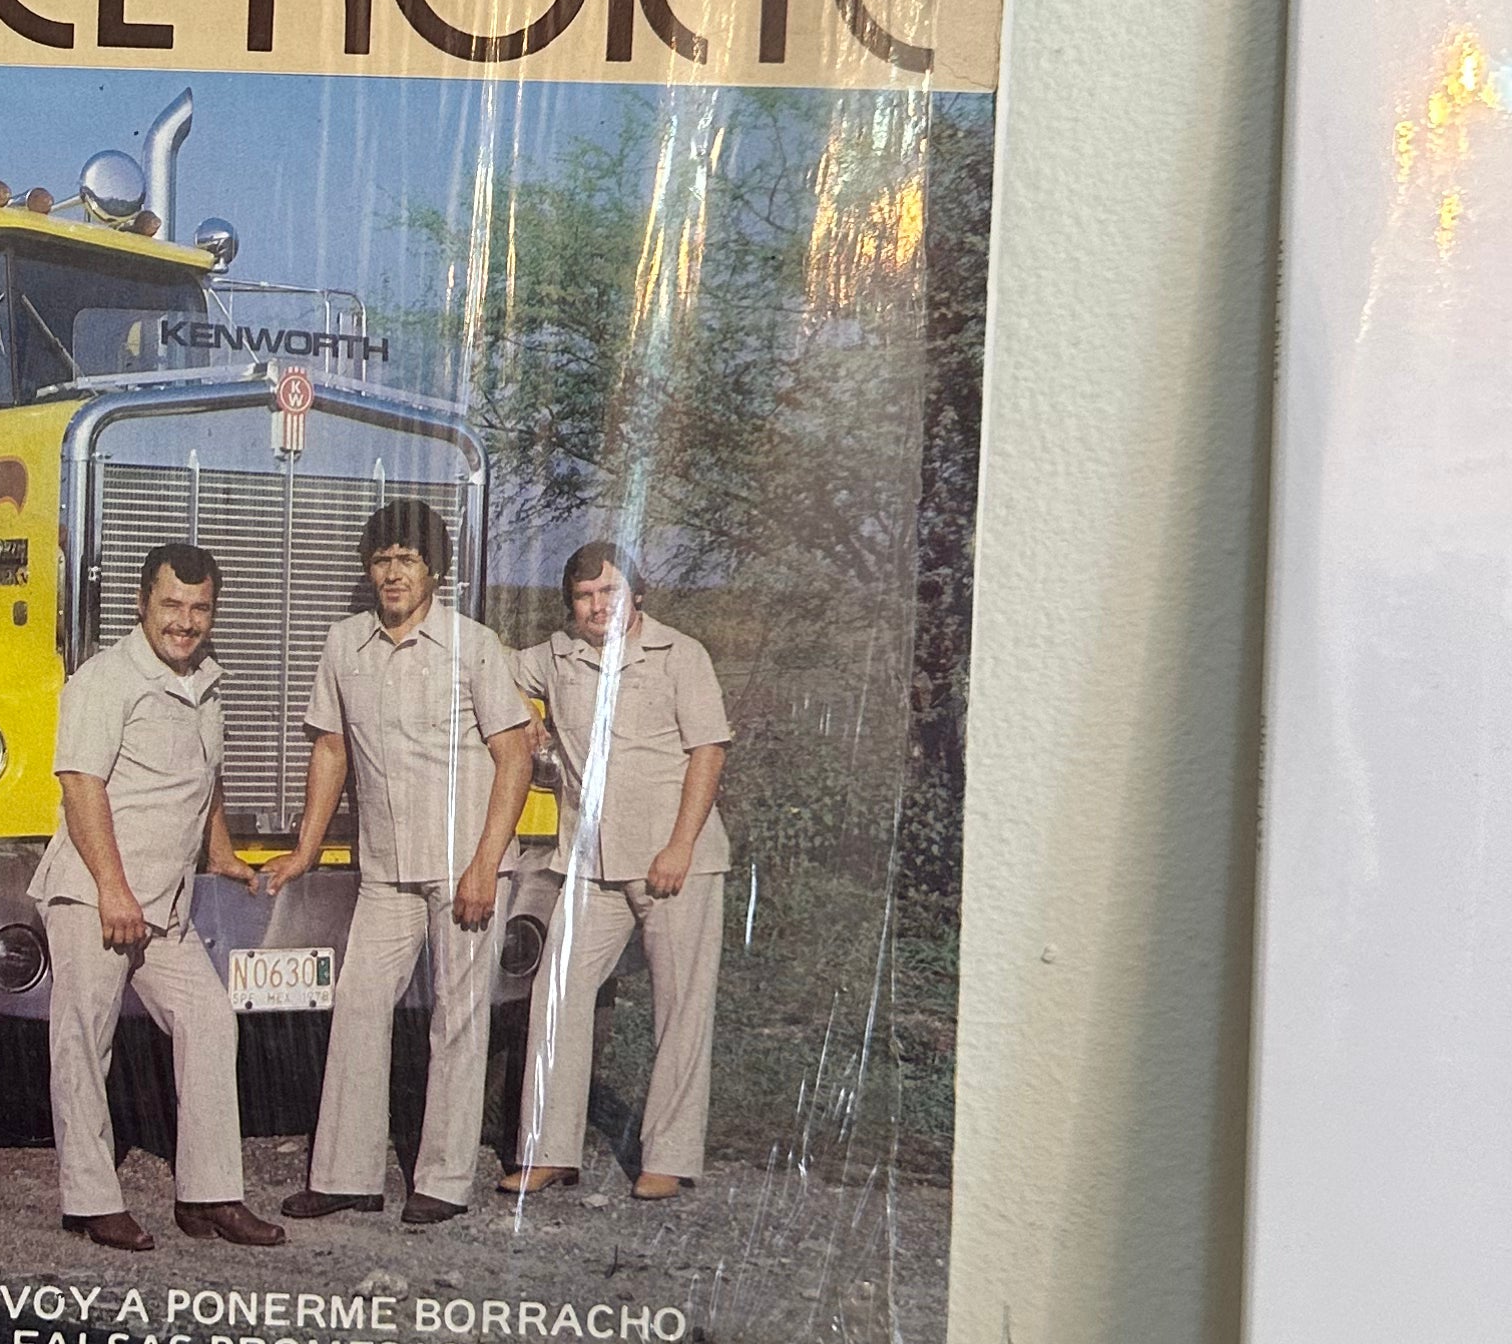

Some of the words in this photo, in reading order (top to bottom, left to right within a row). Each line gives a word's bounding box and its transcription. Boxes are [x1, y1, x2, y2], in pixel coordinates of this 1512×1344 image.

[161, 319, 389, 362] KENWORTH
[116, 1288, 150, 1323] A
[167, 1288, 397, 1331] PONERME
[416, 1297, 687, 1342] BORRACHO
